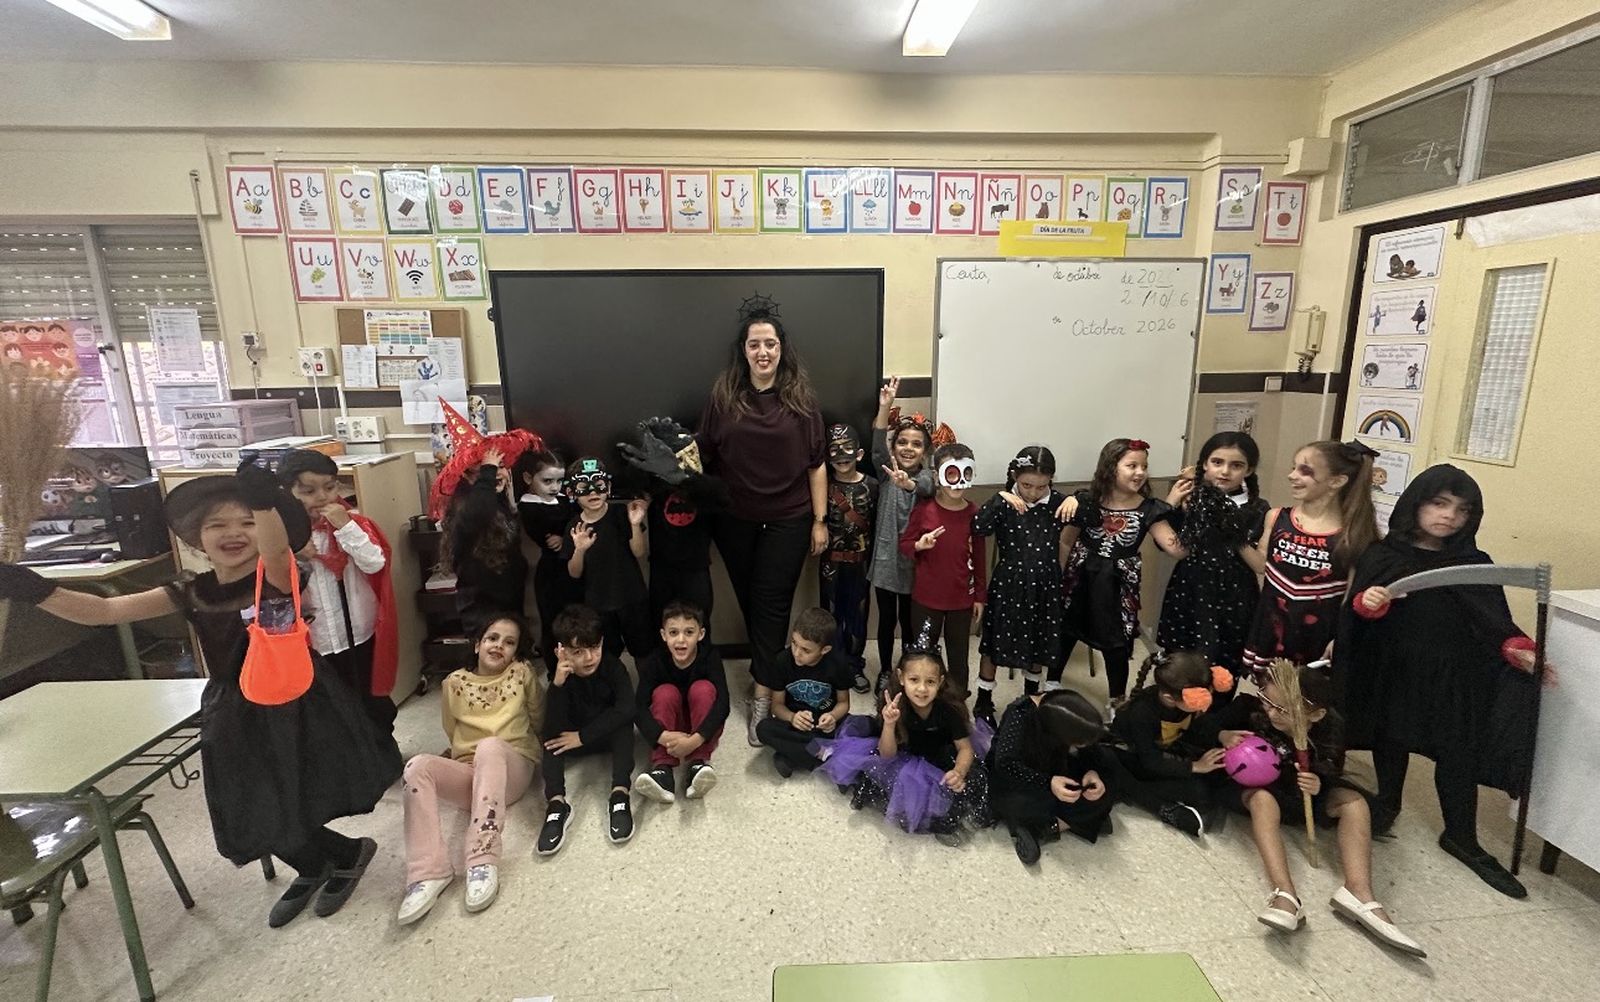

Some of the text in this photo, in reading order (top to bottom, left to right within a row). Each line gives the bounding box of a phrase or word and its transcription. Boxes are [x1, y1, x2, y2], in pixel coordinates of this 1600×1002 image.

[1072, 317, 1126, 337] October
[1136, 317, 1176, 333] 2026
[185, 411, 222, 420] Lengua
[190, 451, 233, 460] Proyecto
[1294, 535, 1327, 547] FEAR
[1278, 539, 1330, 560] CHEER
